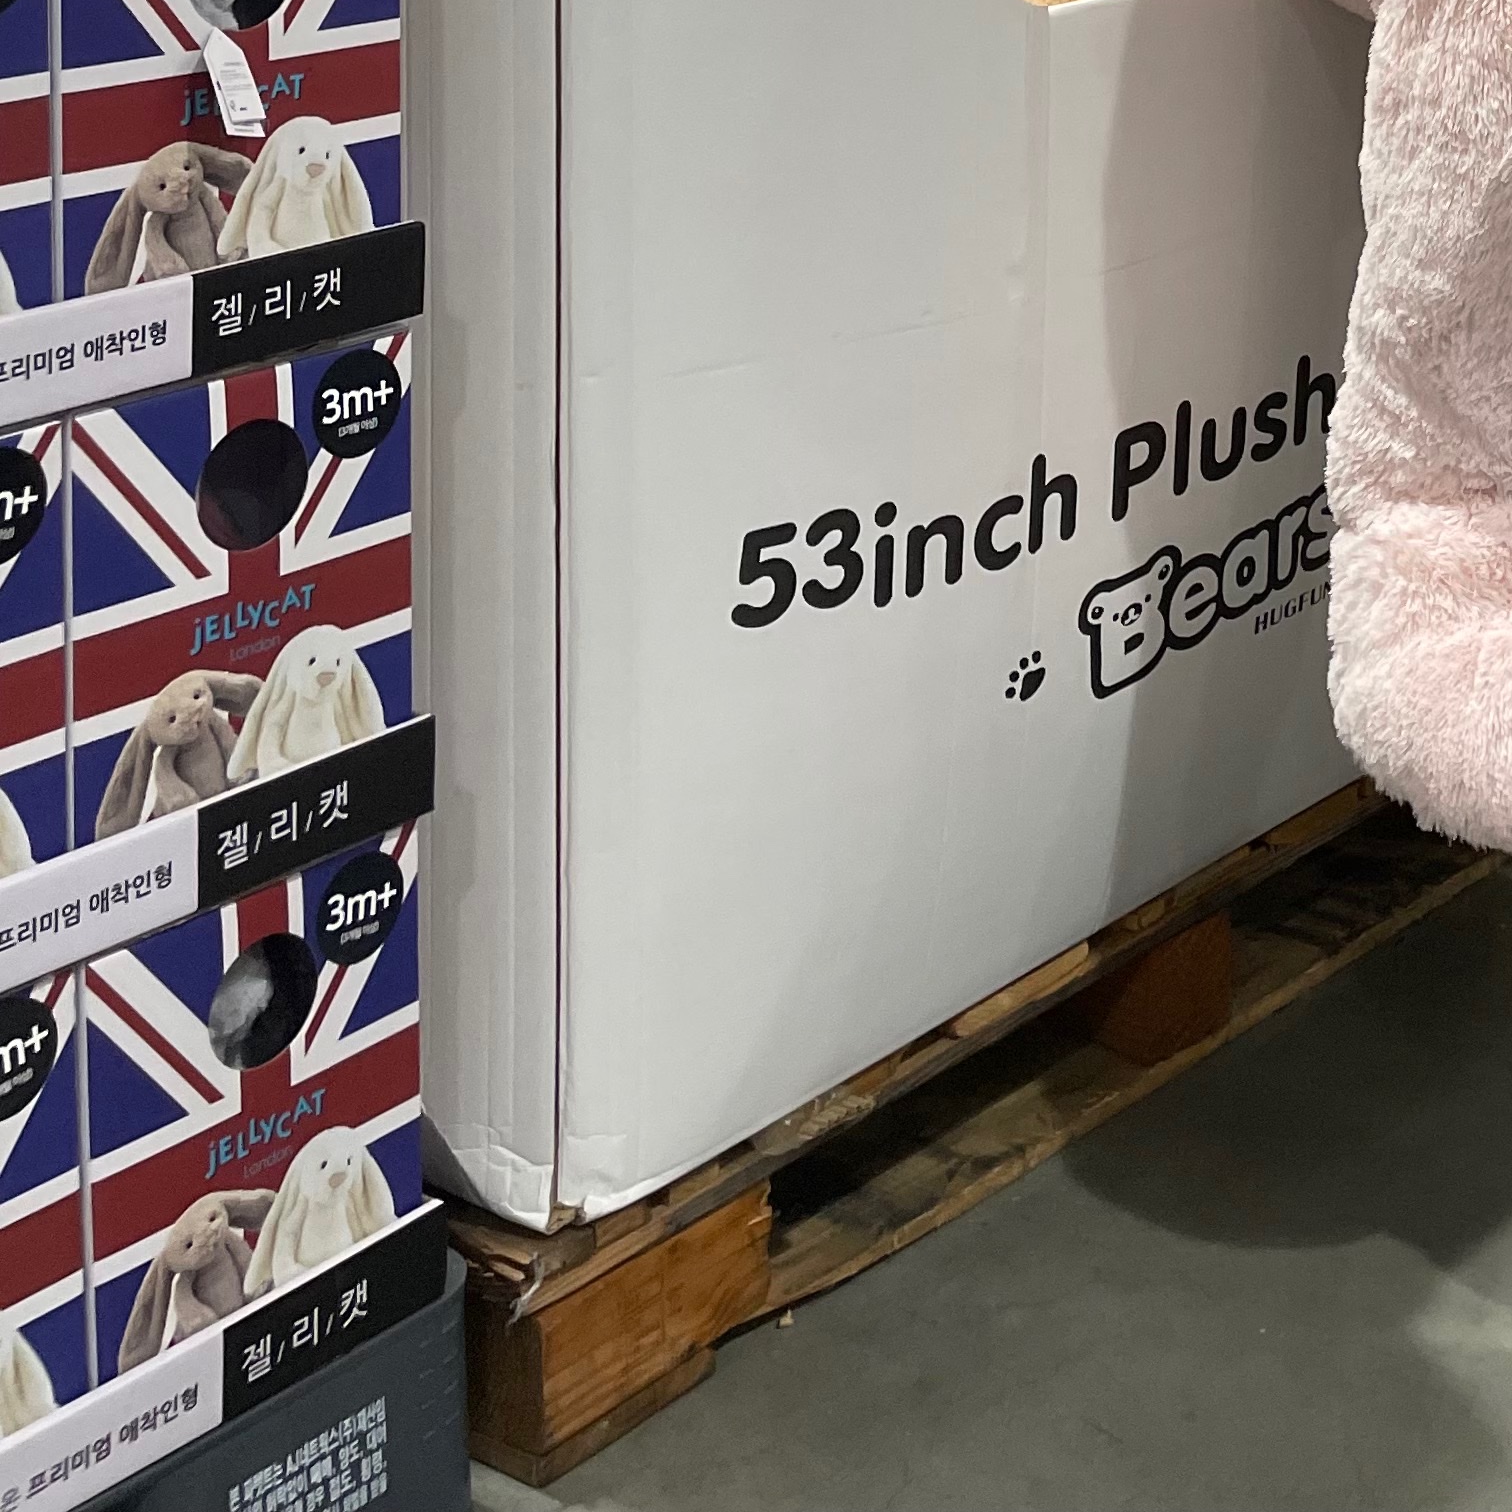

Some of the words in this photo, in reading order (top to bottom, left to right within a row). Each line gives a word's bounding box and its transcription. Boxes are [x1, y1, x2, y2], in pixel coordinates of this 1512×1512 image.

[83, 319, 168, 362] 애착인형
[321, 380, 394, 425] 3m+
[731, 453, 1078, 629] 53inch
[1111, 354, 1337, 522] Plush
[190, 583, 317, 657] jELLYCAT
[1078, 484, 1331, 700] Bears
[229, 634, 281, 662] London
[89, 861, 173, 916] 애착인형
[325, 880, 397, 933] 3m+
[204, 1088, 326, 1180] jELLYCAT
[26, 1432, 112, 1499] 프리미엄
[118, 1381, 199, 1445] 애착인형
